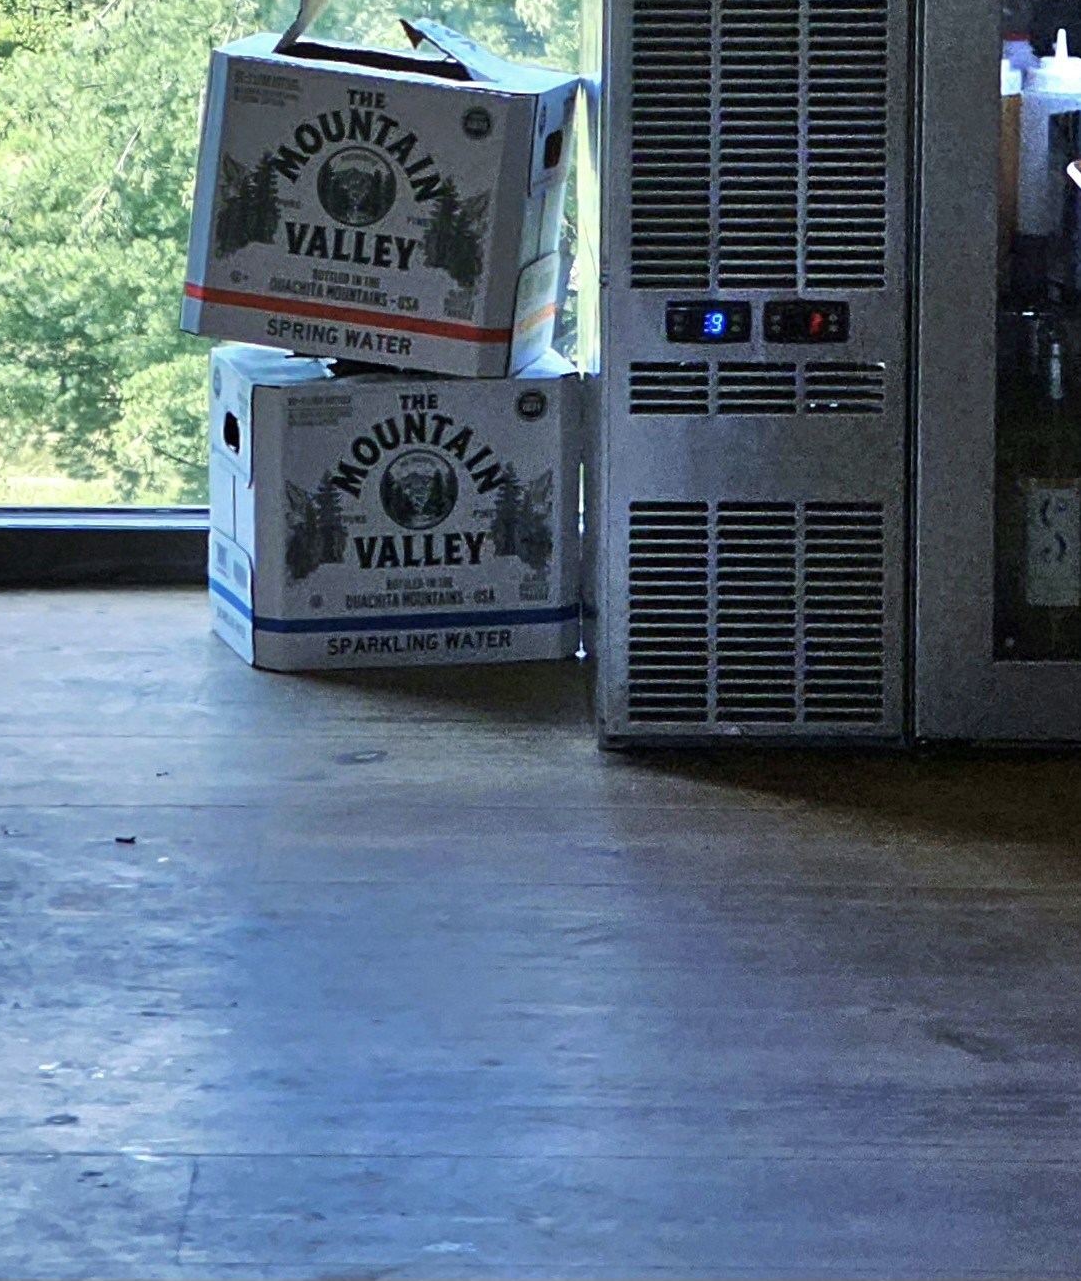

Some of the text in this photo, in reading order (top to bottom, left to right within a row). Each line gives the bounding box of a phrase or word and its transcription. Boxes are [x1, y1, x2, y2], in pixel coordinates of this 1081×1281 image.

[347, 88, 387, 109] THE
[272, 107, 446, 203] MOUNTAIN
[285, 221, 419, 271] VALLEY
[326, 285, 387, 307] MOUNTAINS
[397, 296, 419, 311] USA
[267, 319, 413, 355] SPRING WATER
[400, 393, 439, 411] THE
[330, 412, 506, 500] MOUNTAIN
[353, 531, 486, 569] VALLEY
[327, 628, 512, 656] SPARKLING WATER
